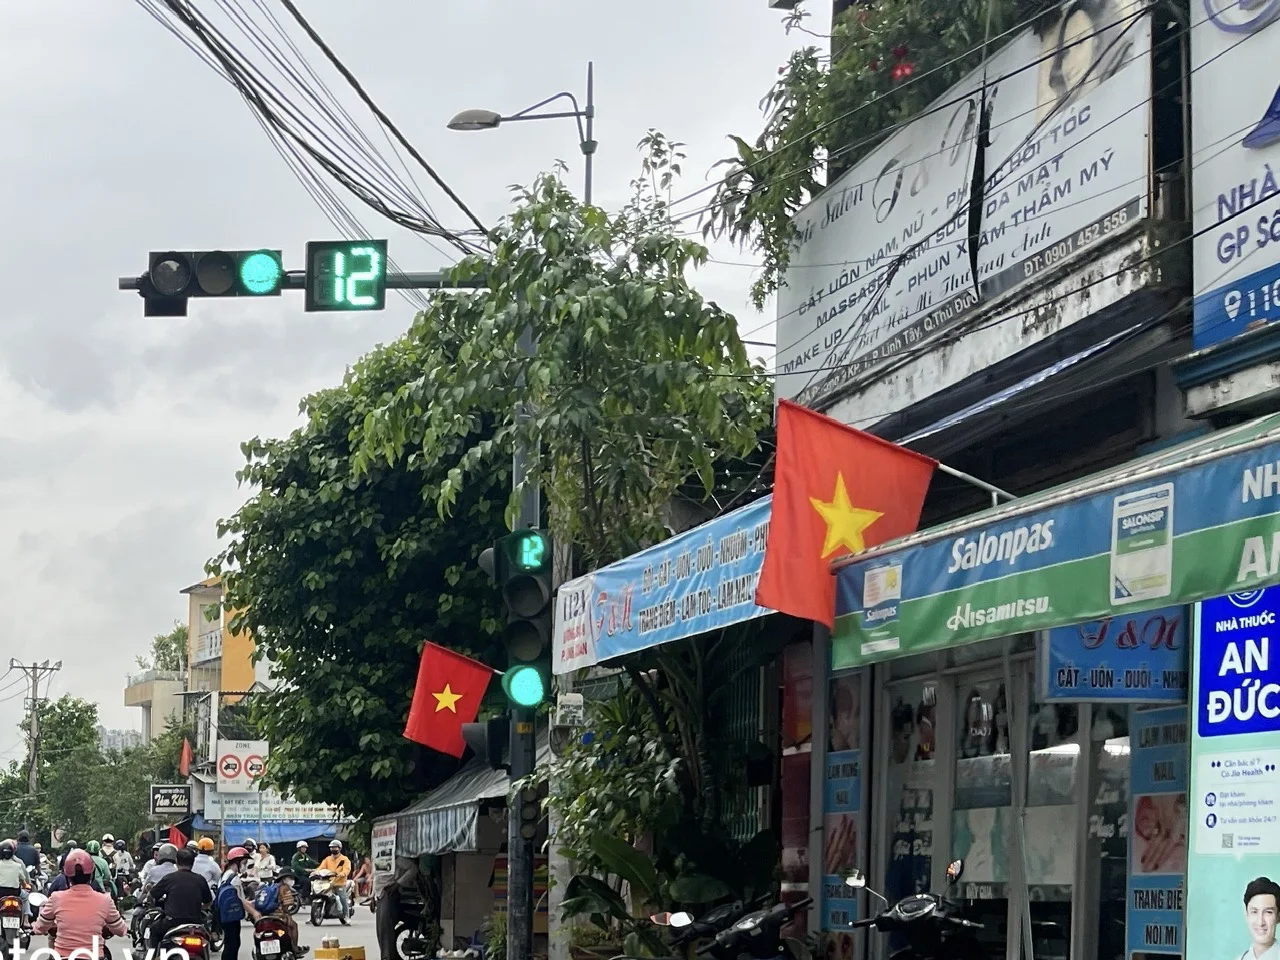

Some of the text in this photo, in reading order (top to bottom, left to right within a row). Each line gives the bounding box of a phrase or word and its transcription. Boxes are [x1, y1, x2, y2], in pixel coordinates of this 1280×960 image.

[1050, 106, 1091, 146] TÓC
[986, 191, 1010, 220] DA
[784, 345, 820, 375] MAKE
[824, 328, 843, 349] UP
[908, 250, 951, 293] PHUN
[1011, 178, 1073, 228] THẨM
[1080, 147, 1116, 187] MỸ
[1024, 257, 1044, 278] ĐT:
[1046, 241, 1074, 267] 0901
[1077, 223, 1100, 248] 452
[1104, 207, 1128, 233] 556
[1217, 225, 1250, 264] GP
[333, 246, 381, 306] 12
[1122, 510, 1165, 530] SALONSIP
[521, 533, 544, 567] 12
[948, 518, 1055, 574] Salonpas
[947, 596, 1052, 631] Hisamitsu
[1216, 610, 1276, 633] NHÀ THUỐC
[1219, 637, 1269, 677] AN
[1207, 678, 1280, 724] ĐỨC
[1242, 767, 1264, 777] Health
[1134, 881, 1182, 910] TRANG ĐIỂ
[1165, 925, 1177, 946] MI
